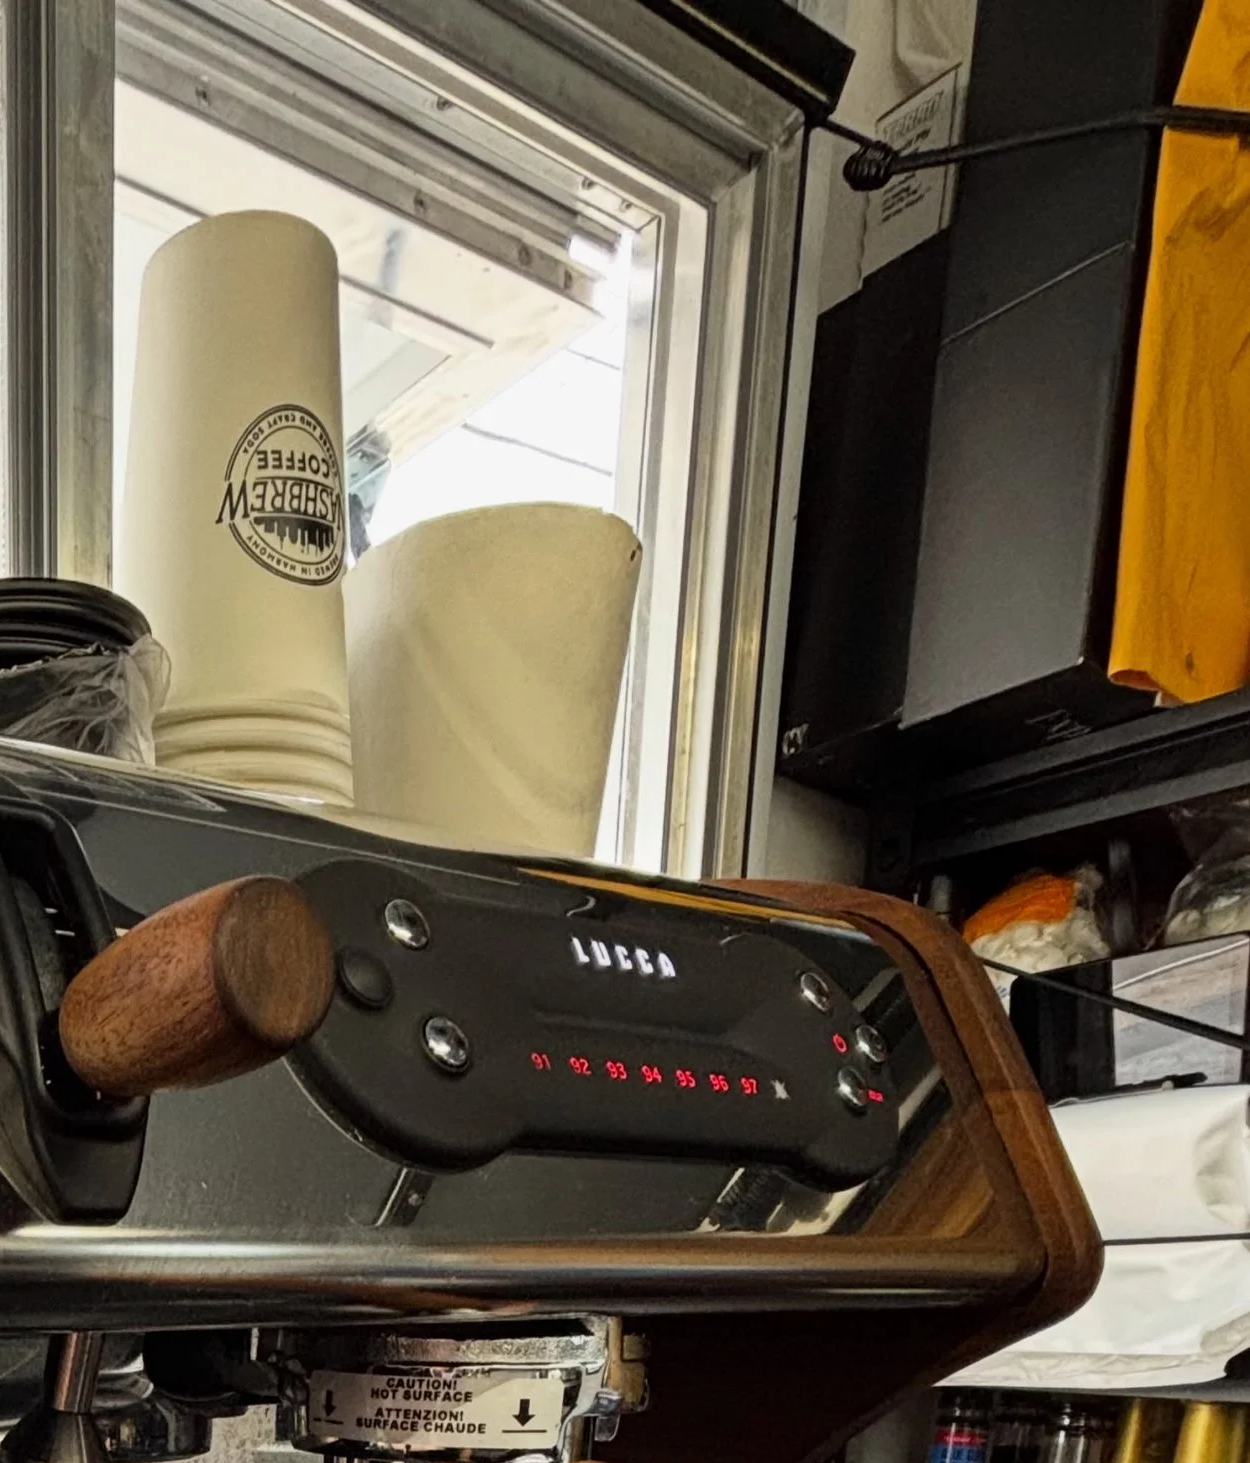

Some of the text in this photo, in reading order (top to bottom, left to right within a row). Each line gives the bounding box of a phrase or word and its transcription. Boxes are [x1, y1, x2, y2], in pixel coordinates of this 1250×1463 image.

[243, 426, 265, 454] SODA
[256, 450, 330, 478] COFFEE
[246, 534, 296, 573] HARMONY
[301, 566, 312, 576] IN
[570, 933, 677, 979] LUCCA
[530, 1052, 759, 1095] 91 92 93 94 95 96 97
[371, 1387, 473, 1402] HOT SURFACE
[386, 1378, 457, 1391] CAUTION!
[356, 1417, 486, 1434] SURFACE CHAUDE
[375, 1407, 464, 1422] ATTENZION!
